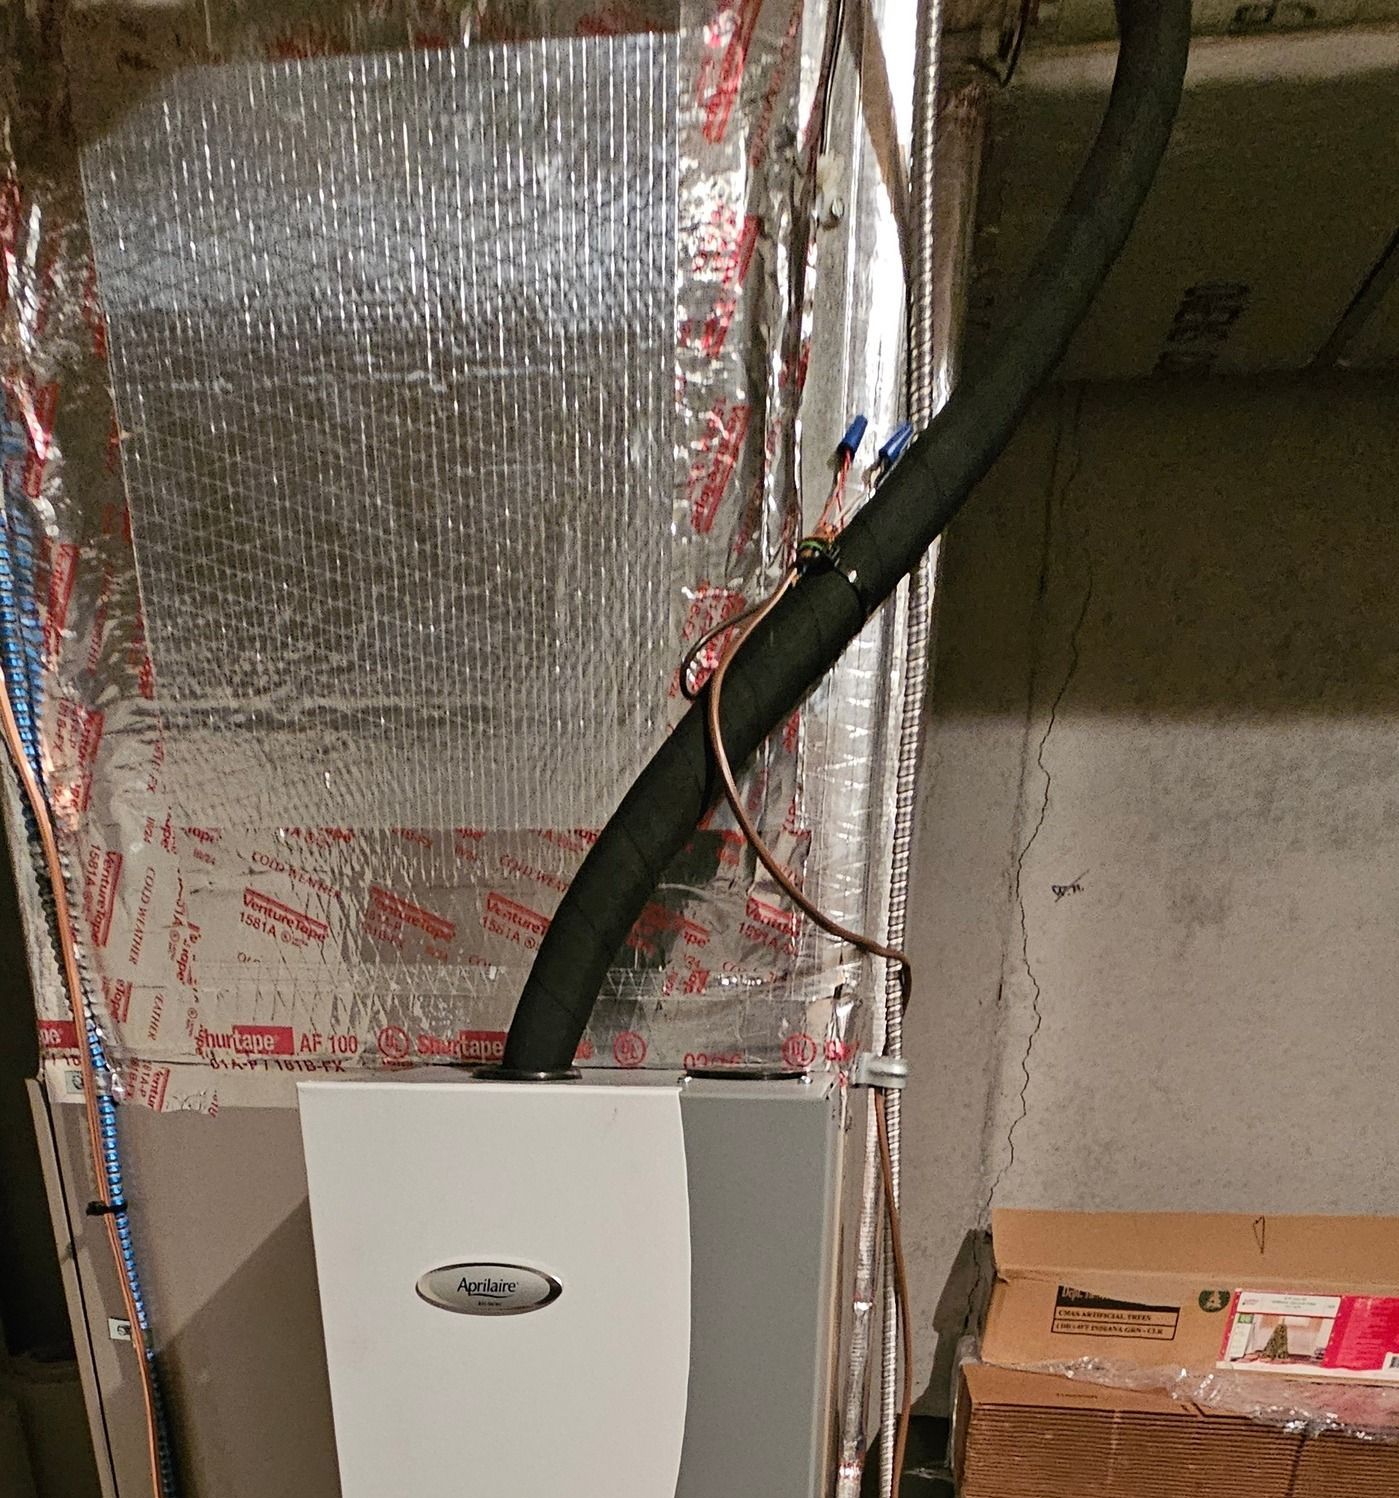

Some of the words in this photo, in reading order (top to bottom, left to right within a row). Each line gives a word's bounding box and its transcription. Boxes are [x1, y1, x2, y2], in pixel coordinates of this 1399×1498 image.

[140, 866, 156, 904] COLD
[239, 911, 278, 939] 1581A
[242, 892, 330, 942] VentureTape
[301, 1032, 322, 1053] AF
[329, 1033, 359, 1055] 100
[456, 1276, 517, 1297] Aprilaire
